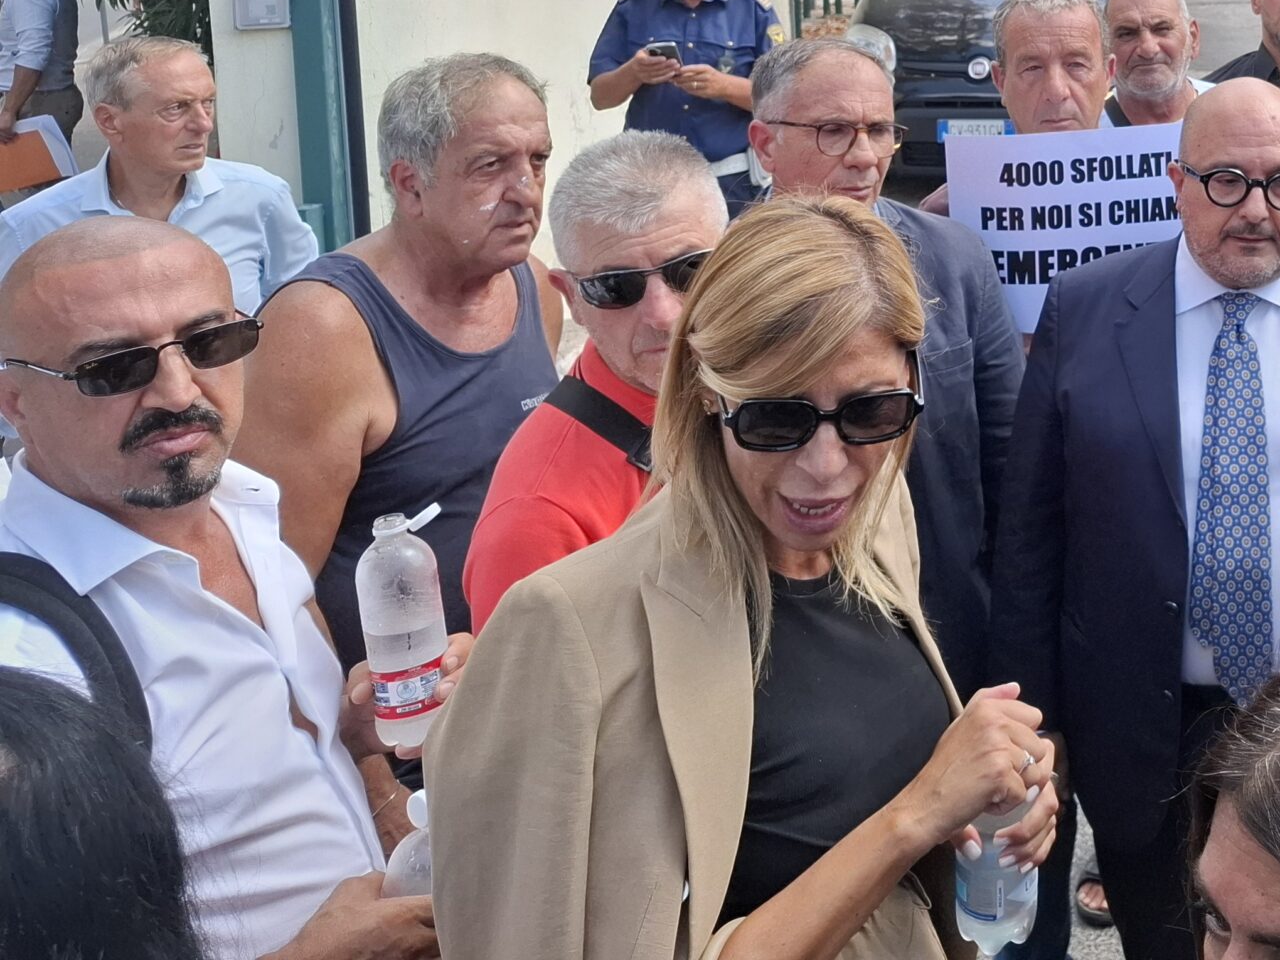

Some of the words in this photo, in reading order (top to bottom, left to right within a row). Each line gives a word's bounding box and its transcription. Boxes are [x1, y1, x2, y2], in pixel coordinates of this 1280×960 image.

[1000, 160, 1065, 187] 4000
[981, 206, 1025, 231] PER
[1031, 204, 1072, 230] NOI
[1078, 202, 1102, 228] SI
